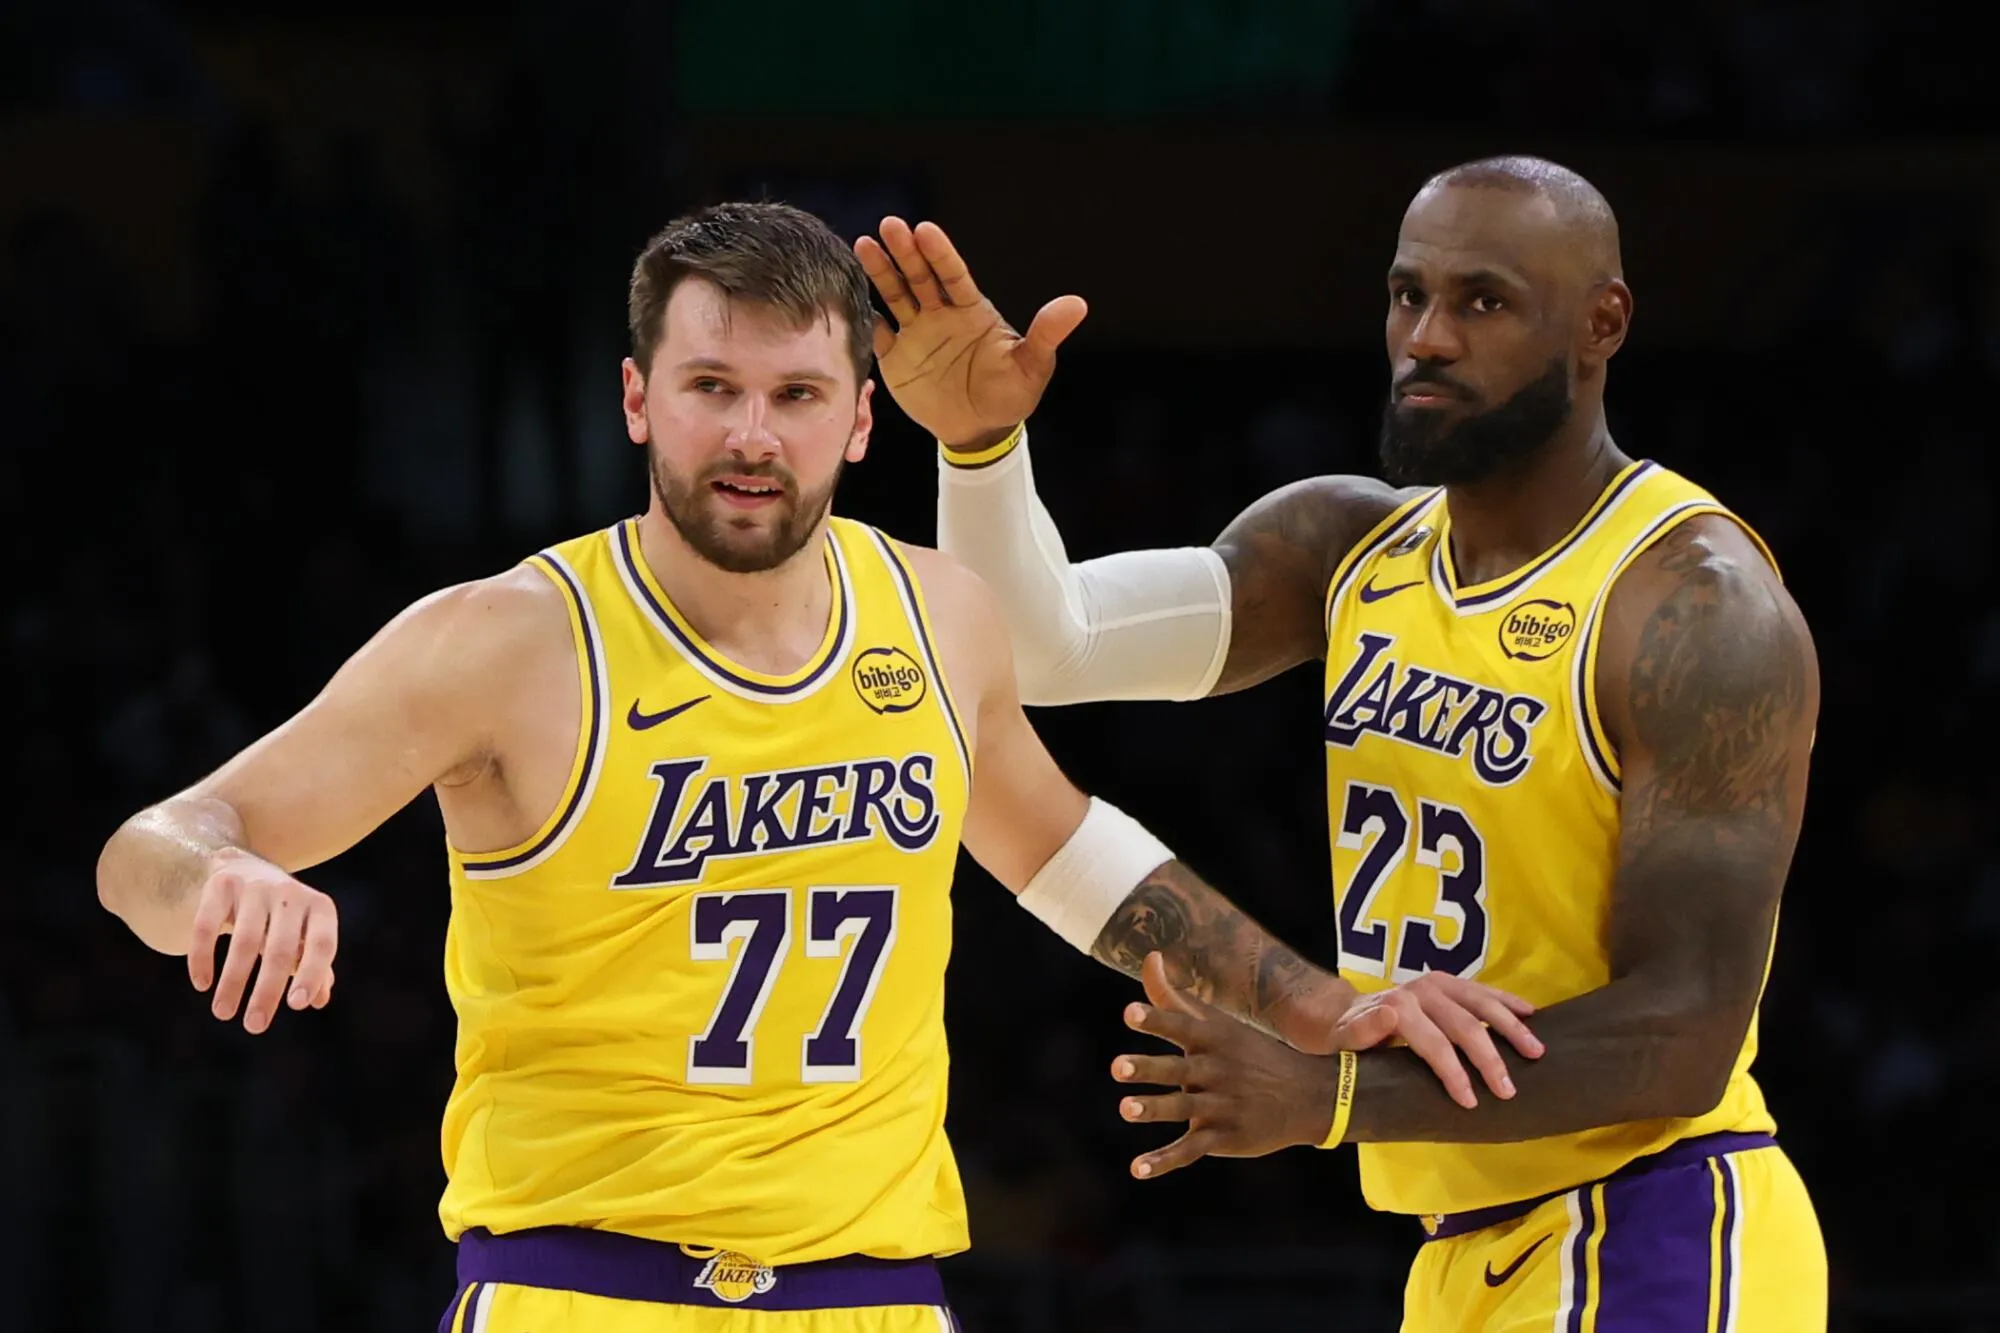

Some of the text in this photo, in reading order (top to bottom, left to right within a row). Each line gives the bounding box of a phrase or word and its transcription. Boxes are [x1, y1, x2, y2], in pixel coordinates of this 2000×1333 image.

[1508, 614, 1570, 644] bibigo
[857, 664, 919, 691] bibigo
[874, 687, 901, 700] 비비고
[1325, 632, 1547, 786] LAKERS
[610, 754, 940, 887] LAKERS
[1336, 779, 1487, 984] 23
[687, 885, 899, 1084] 77
[698, 1260, 774, 1292] LAKERS
